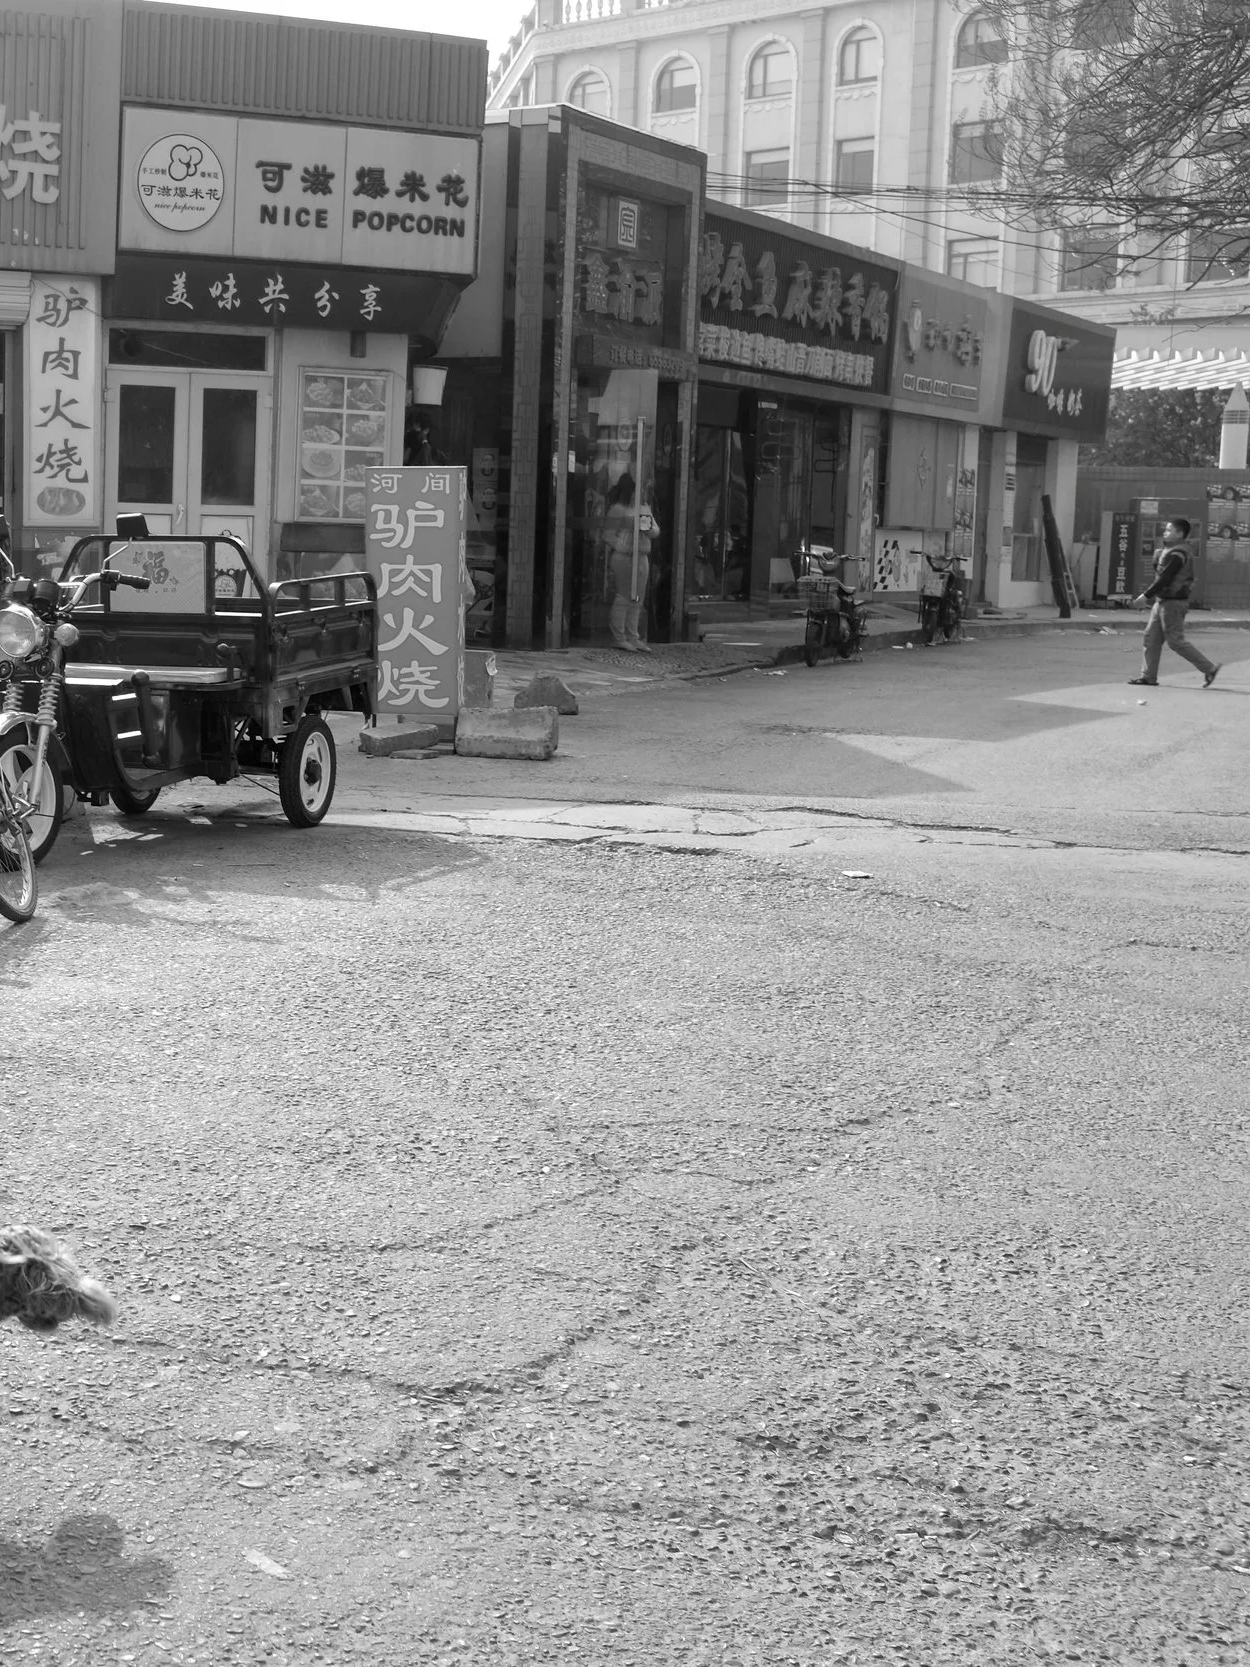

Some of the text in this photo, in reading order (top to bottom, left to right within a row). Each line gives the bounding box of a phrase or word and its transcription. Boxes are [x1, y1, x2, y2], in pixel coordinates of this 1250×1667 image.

[141, 185, 220, 200] 可滋爆米花
[255, 160, 469, 208] 可滋爆米花
[260, 204, 465, 237] NICE POPCORN
[164, 271, 382, 321] 美味共分享
[33, 287, 91, 483] 驴肉火烧
[370, 472, 451, 494] 河间
[370, 501, 450, 708] 驴肉火烧
